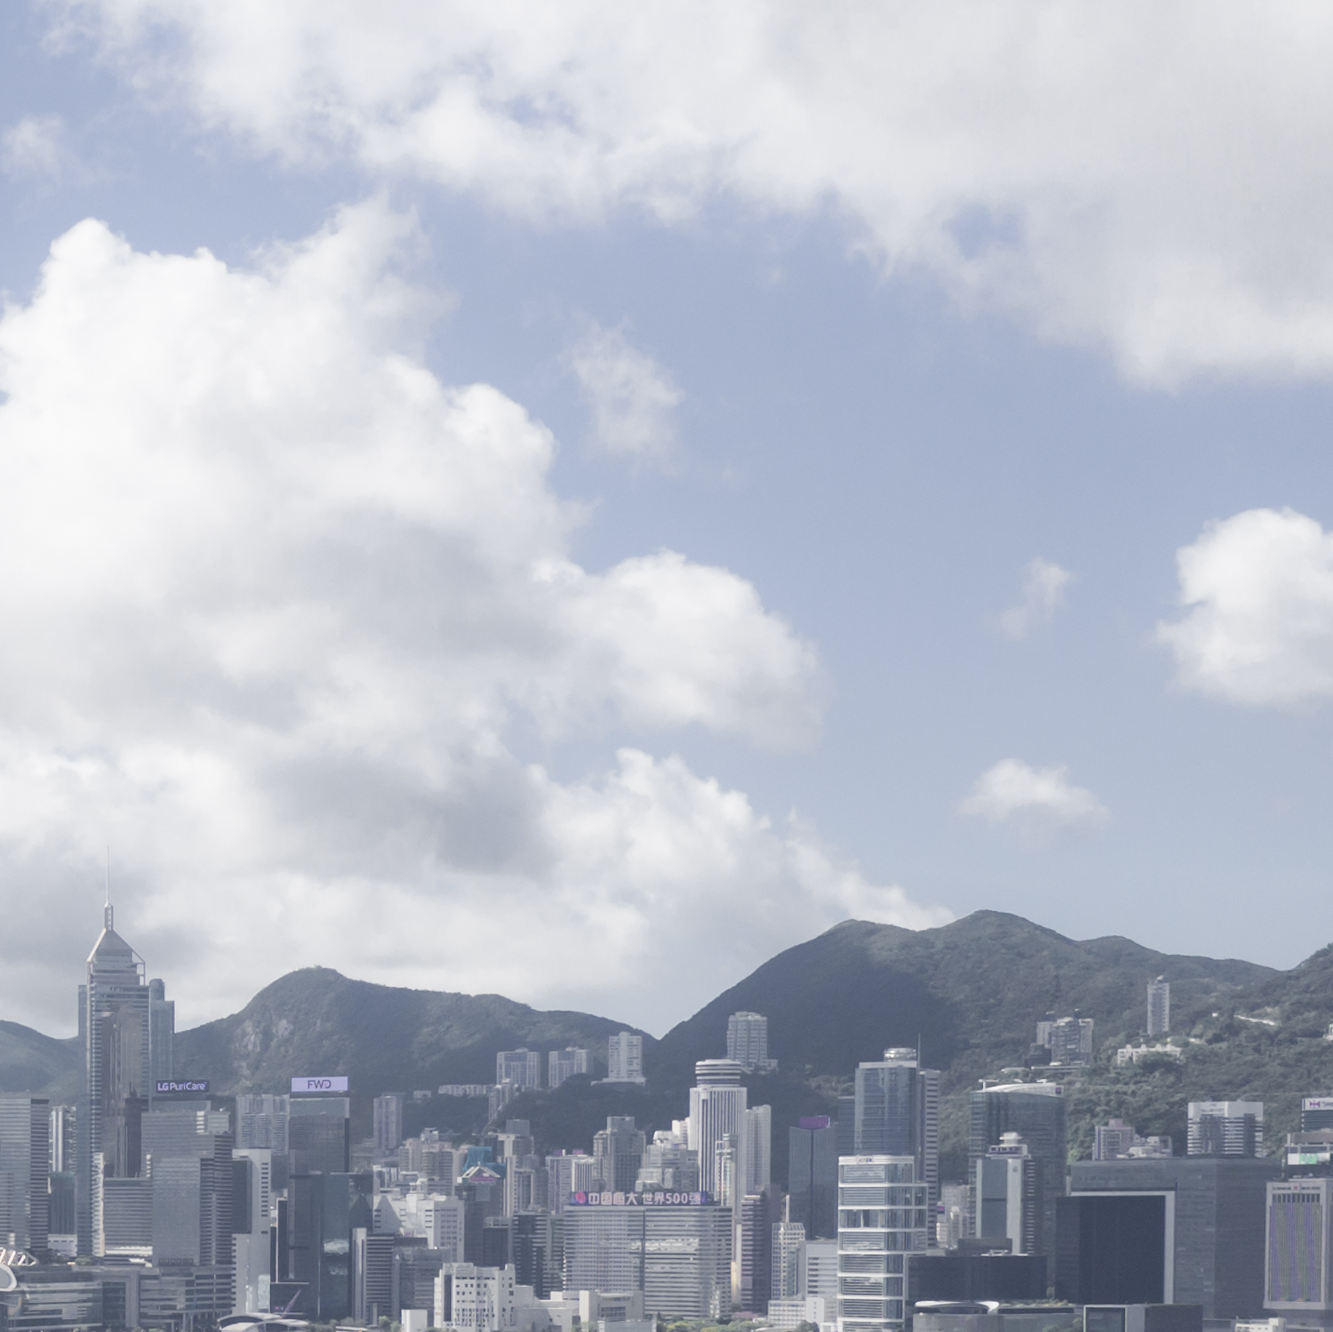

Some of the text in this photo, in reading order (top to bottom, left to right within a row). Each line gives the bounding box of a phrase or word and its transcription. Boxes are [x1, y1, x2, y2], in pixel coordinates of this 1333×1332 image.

[157, 1081, 205, 1091] LG PuriCare
[307, 1079, 332, 1089] FWD
[588, 1191, 638, 1206] 中国恒大
